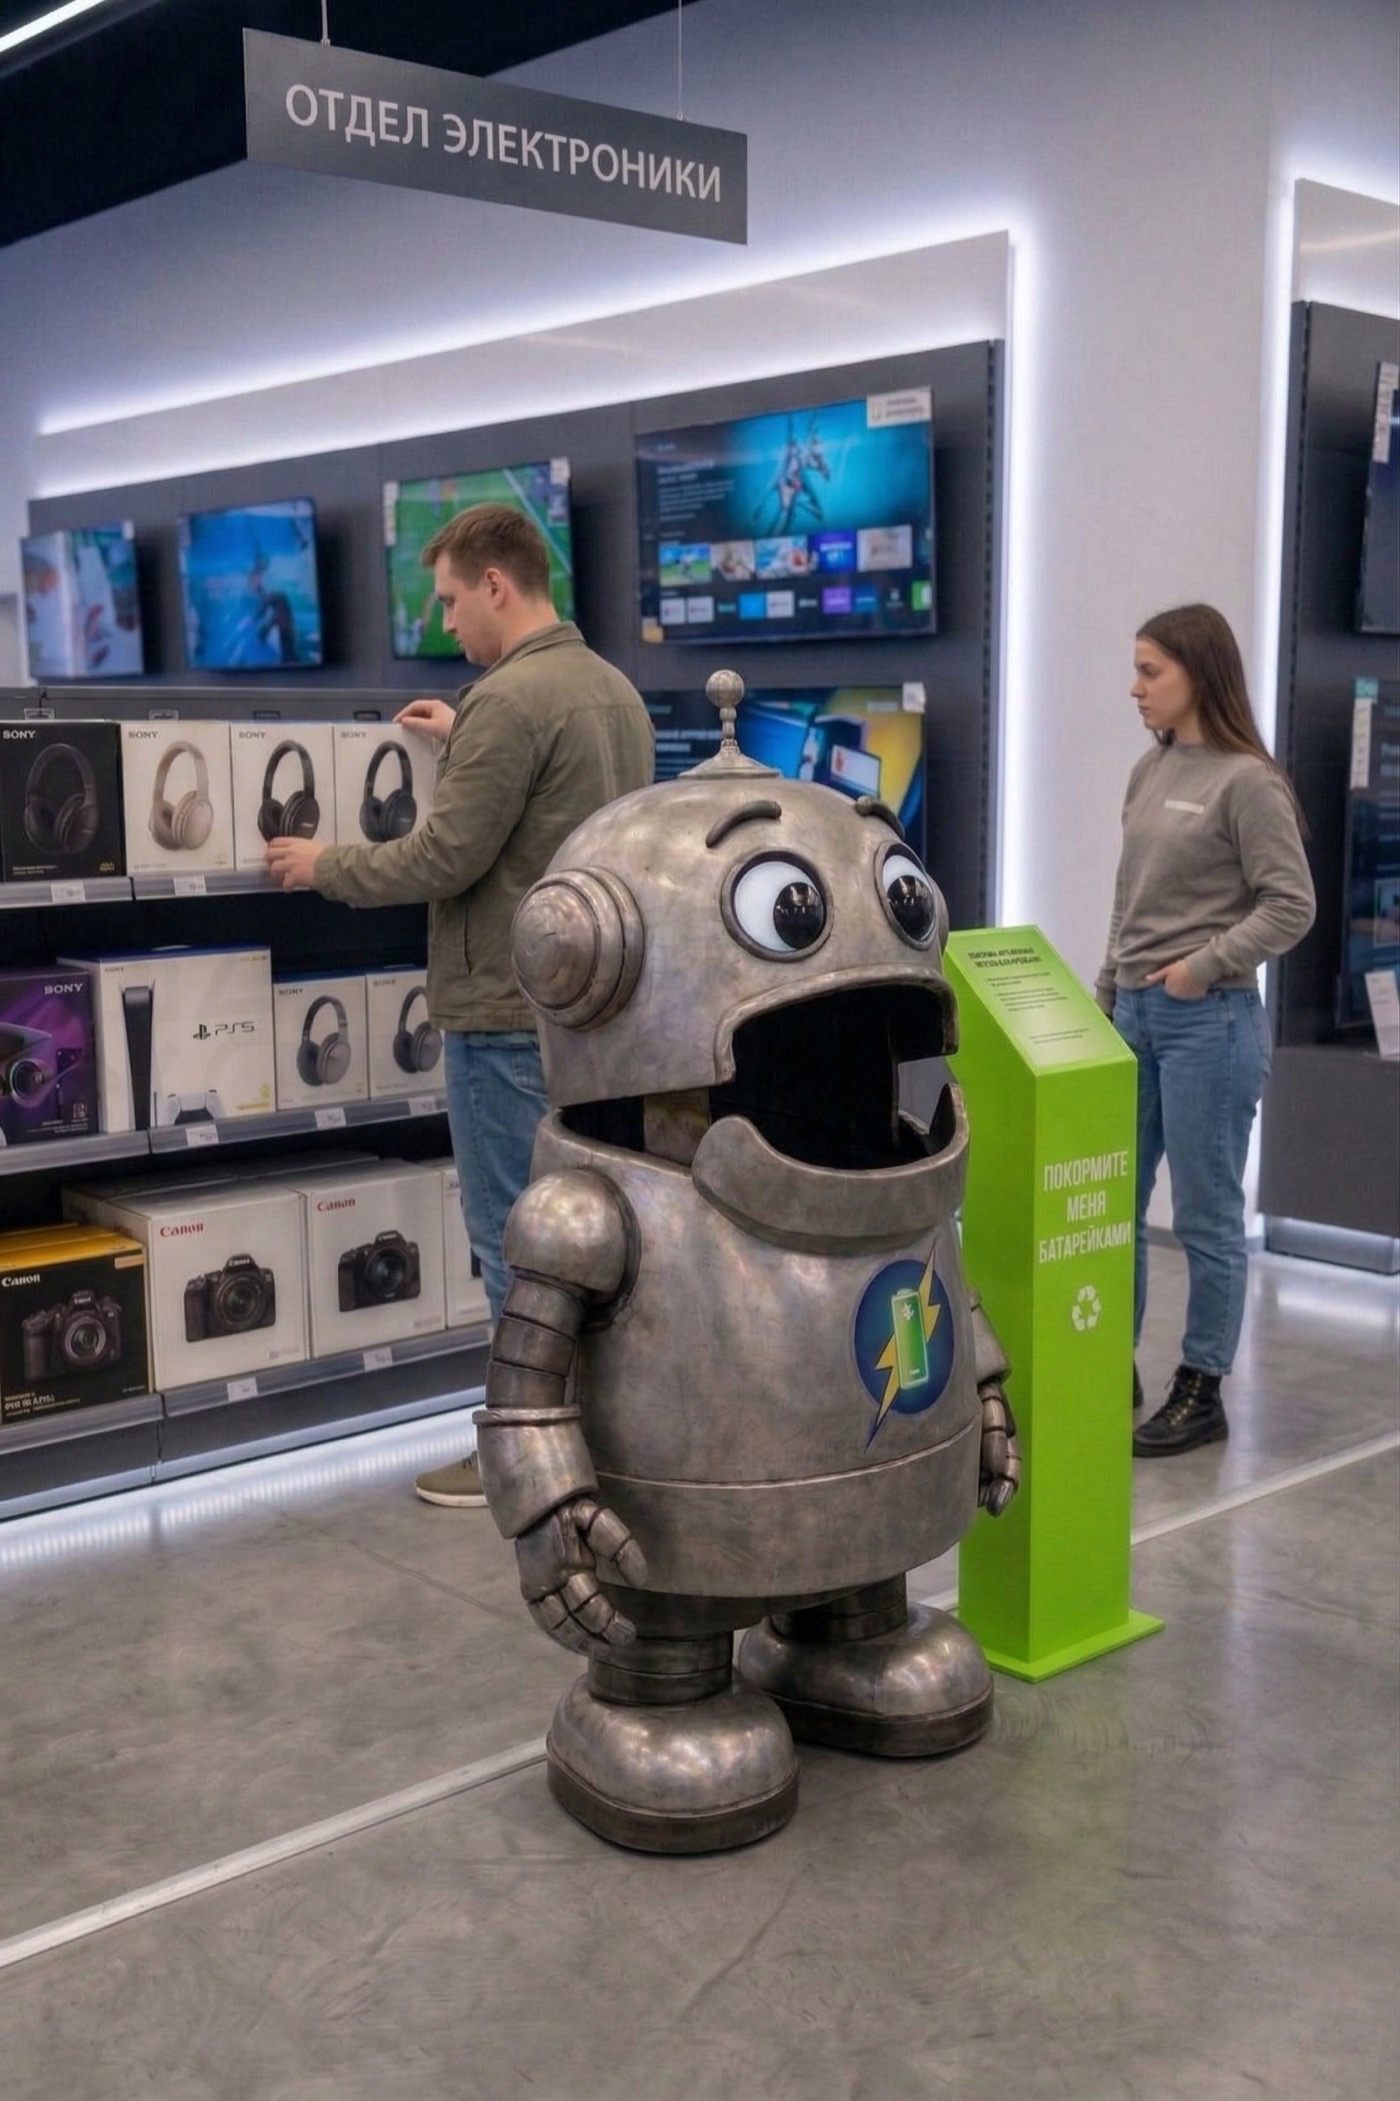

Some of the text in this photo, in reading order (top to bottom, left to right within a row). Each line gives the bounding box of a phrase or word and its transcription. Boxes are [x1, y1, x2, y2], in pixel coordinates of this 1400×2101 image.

[285, 84, 720, 202] ОТДЕЛ ЭЛЕКТРОНИКИ
[3, 730, 36, 739] SONY
[128, 731, 158, 739] SONY
[44, 983, 83, 994] SONY
[215, 1021, 255, 1035] PS5
[1043, 1150, 1129, 1192] ПОКОРМИТЕ
[317, 1198, 356, 1212] Canon
[1066, 1189, 1106, 1224] МЕНЯ
[160, 1222, 205, 1238] Canon
[1039, 1221, 1131, 1265] БАТАРЕЙКАМИ
[1, 1273, 41, 1287] Canon
